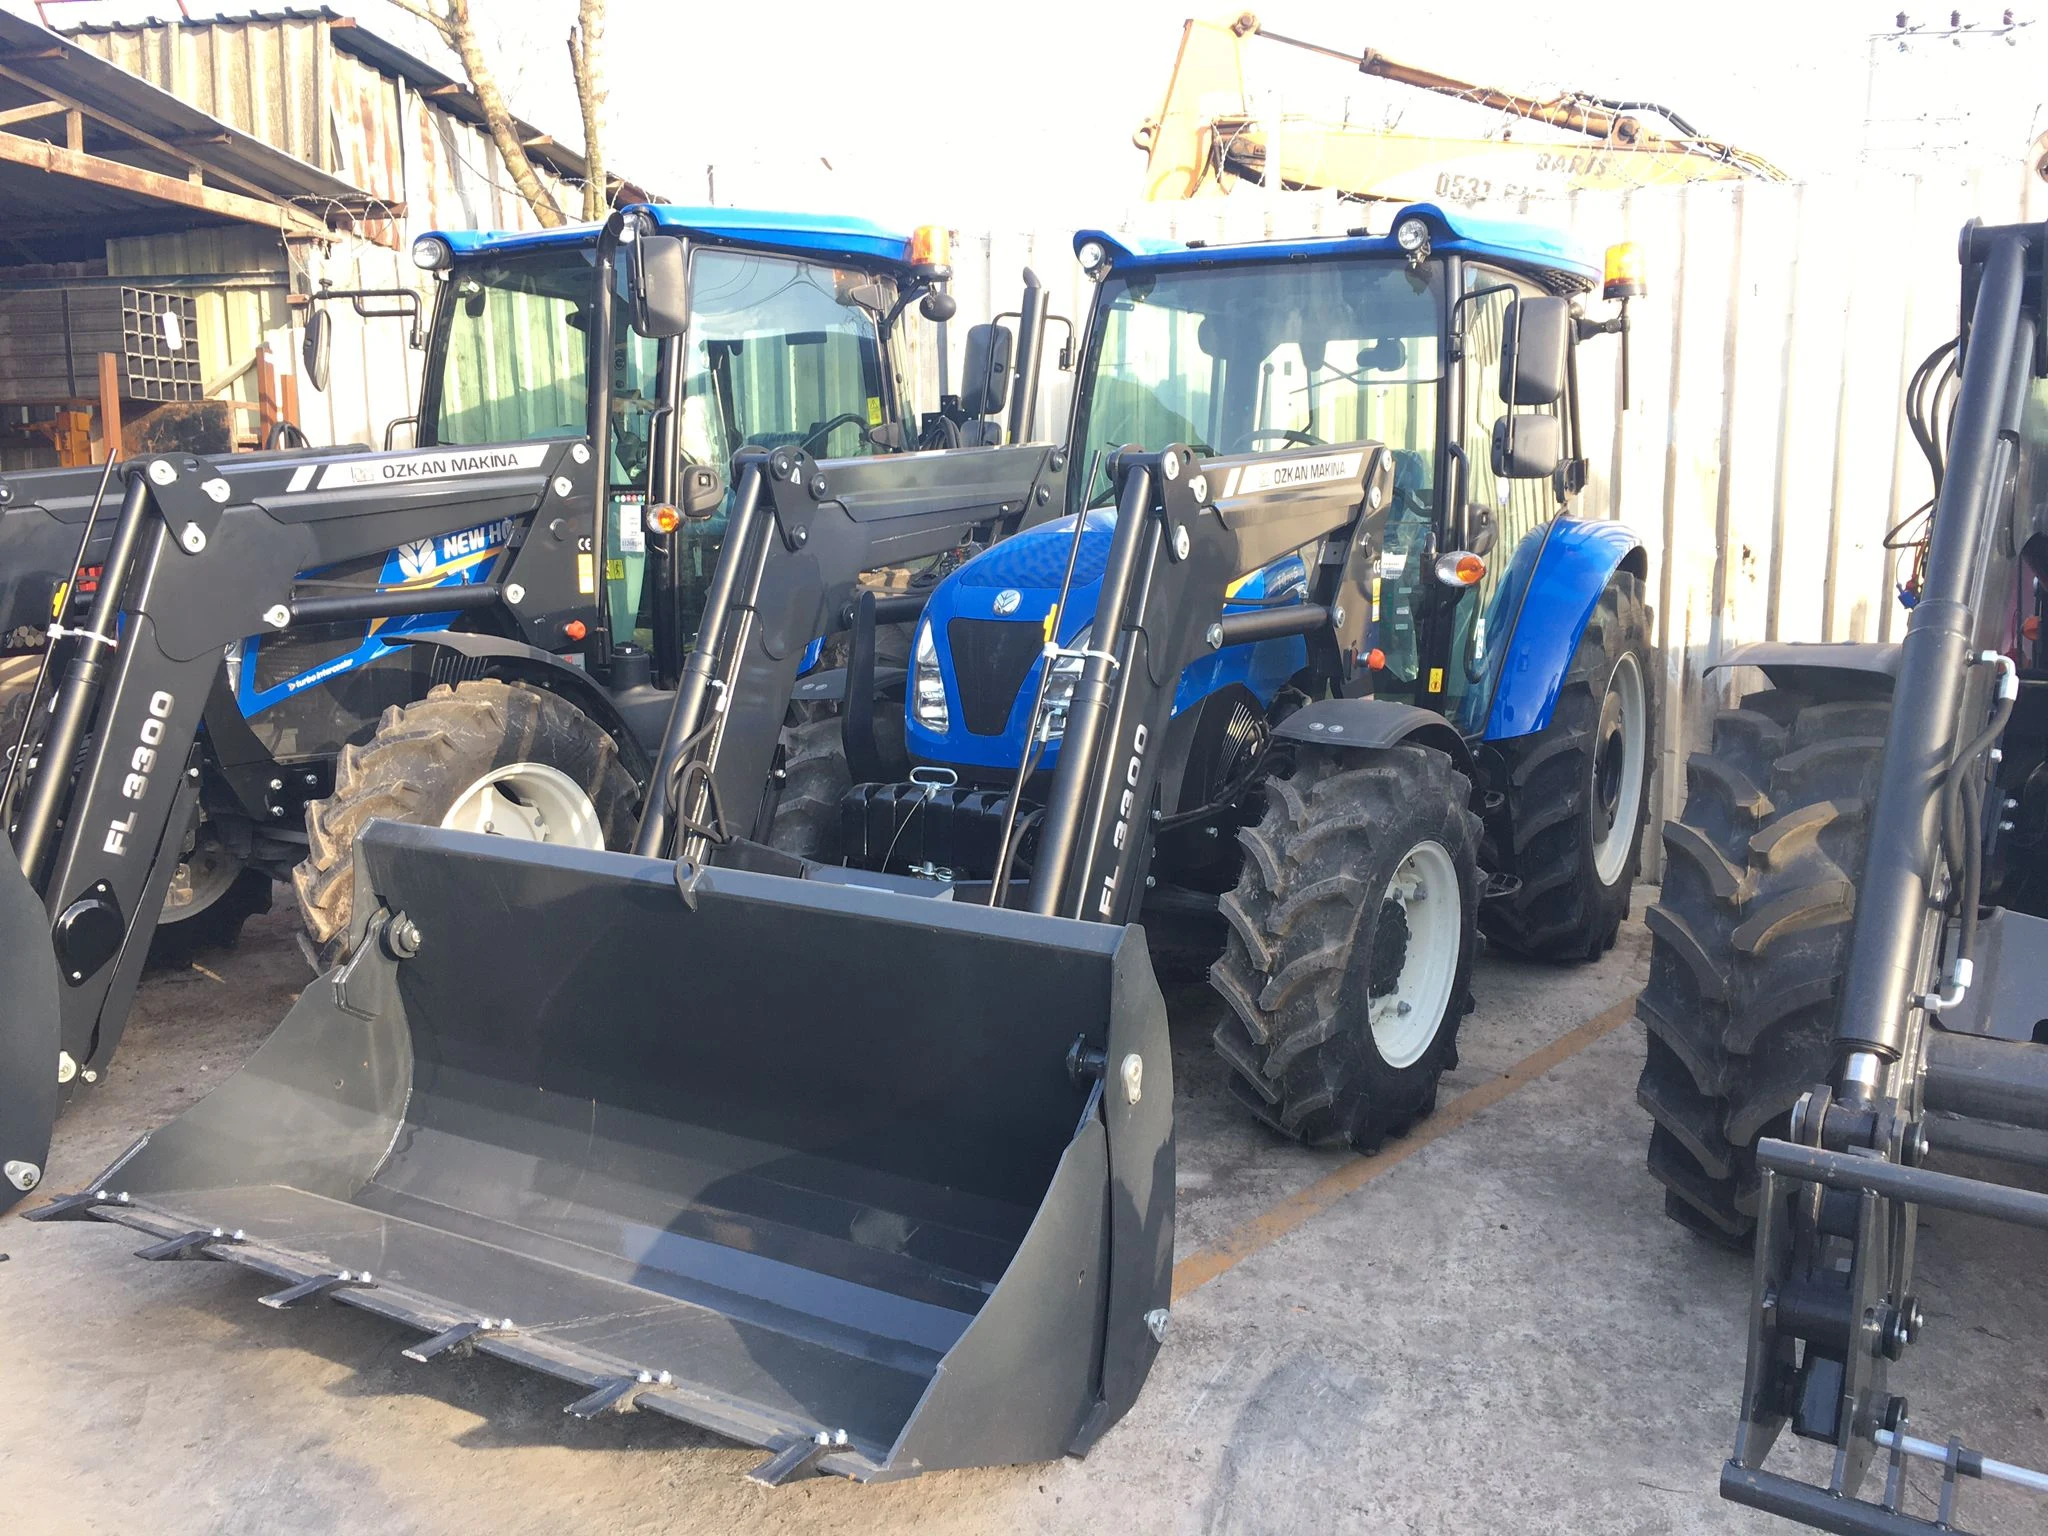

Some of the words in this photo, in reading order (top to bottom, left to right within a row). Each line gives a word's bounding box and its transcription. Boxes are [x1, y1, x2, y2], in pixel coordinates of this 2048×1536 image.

[451, 452, 519, 472] MAKİNA
[443, 526, 485, 560] NEW
[578, 538, 591, 550] CE
[296, 675, 317, 688] turbo
[103, 811, 138, 857] FL
[122, 690, 175, 800] 3300
[1098, 865, 1120, 917] FL
[1113, 723, 1149, 851] 3300
